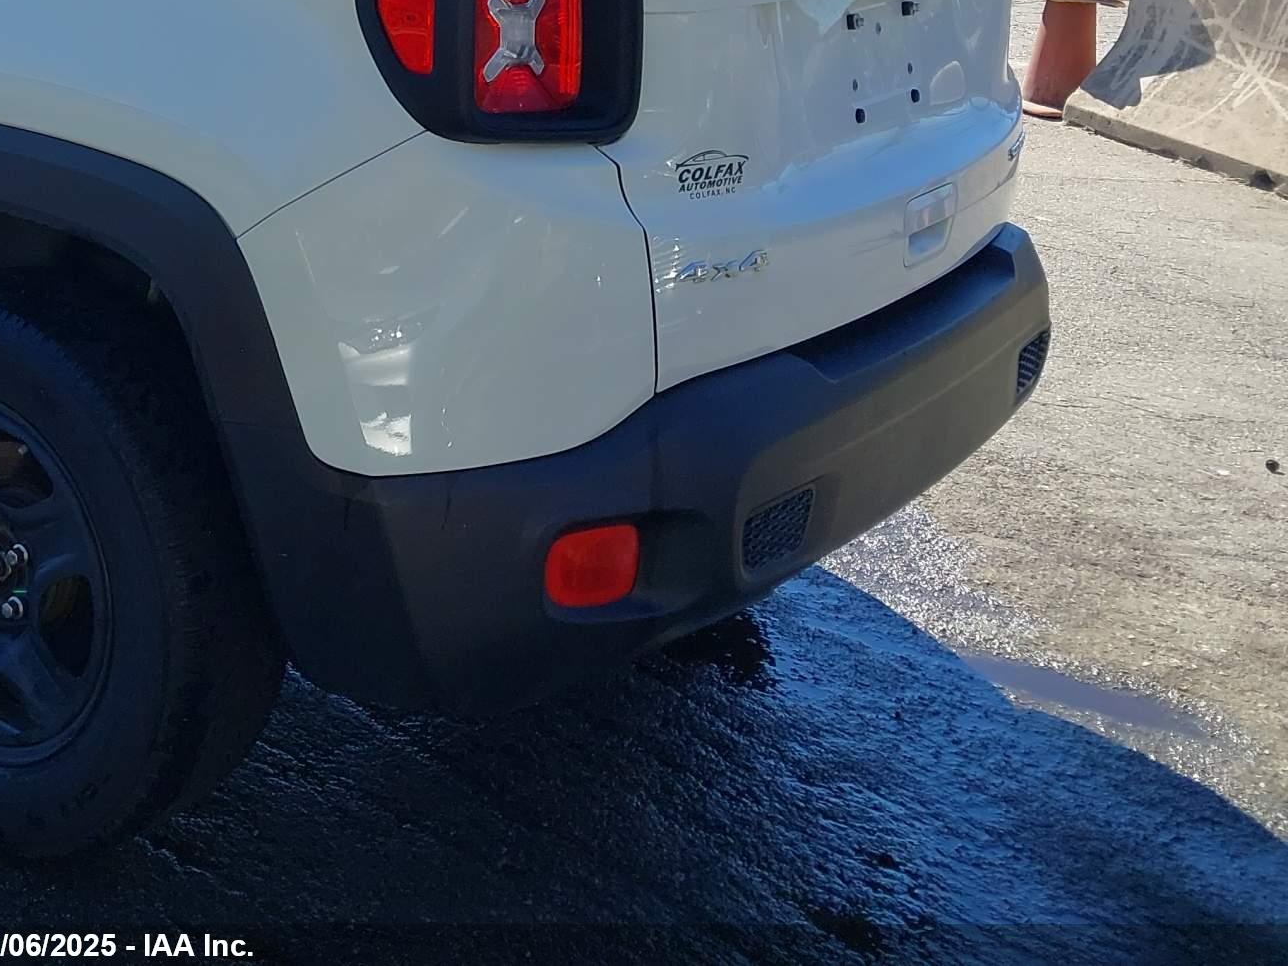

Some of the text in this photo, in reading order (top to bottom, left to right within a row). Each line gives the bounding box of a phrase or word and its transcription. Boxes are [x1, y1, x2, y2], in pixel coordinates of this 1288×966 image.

[678, 161, 746, 184] COLFAX
[678, 176, 744, 193] AUTOMOTIVE
[725, 187, 736, 195] NC
